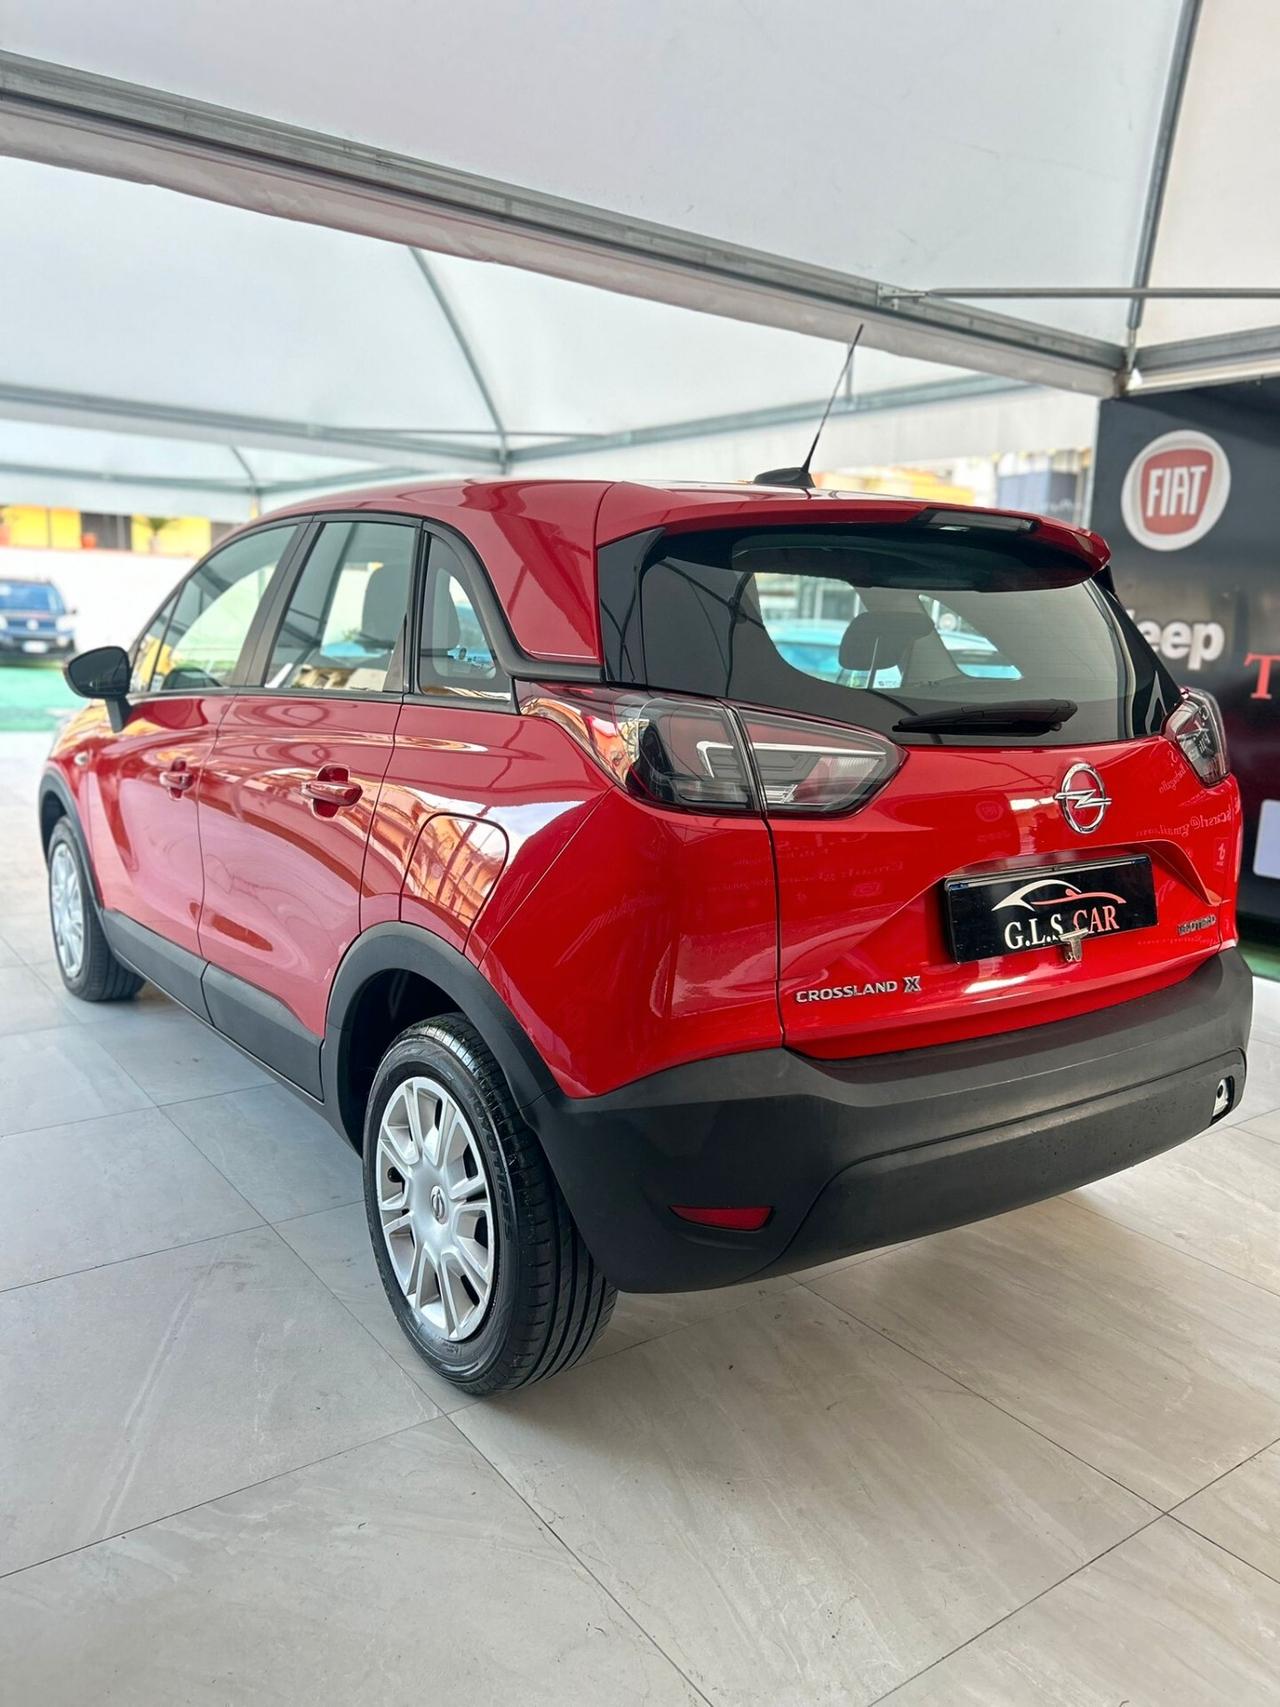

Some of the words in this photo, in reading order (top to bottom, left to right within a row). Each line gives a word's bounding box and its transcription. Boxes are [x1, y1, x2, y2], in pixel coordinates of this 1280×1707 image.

[1146, 465, 1207, 518] FIAT
[1127, 609, 1225, 670] eep
[1072, 905, 1120, 935] CAR
[796, 981, 898, 1003] CROSSLAND
[903, 976, 922, 993] X
